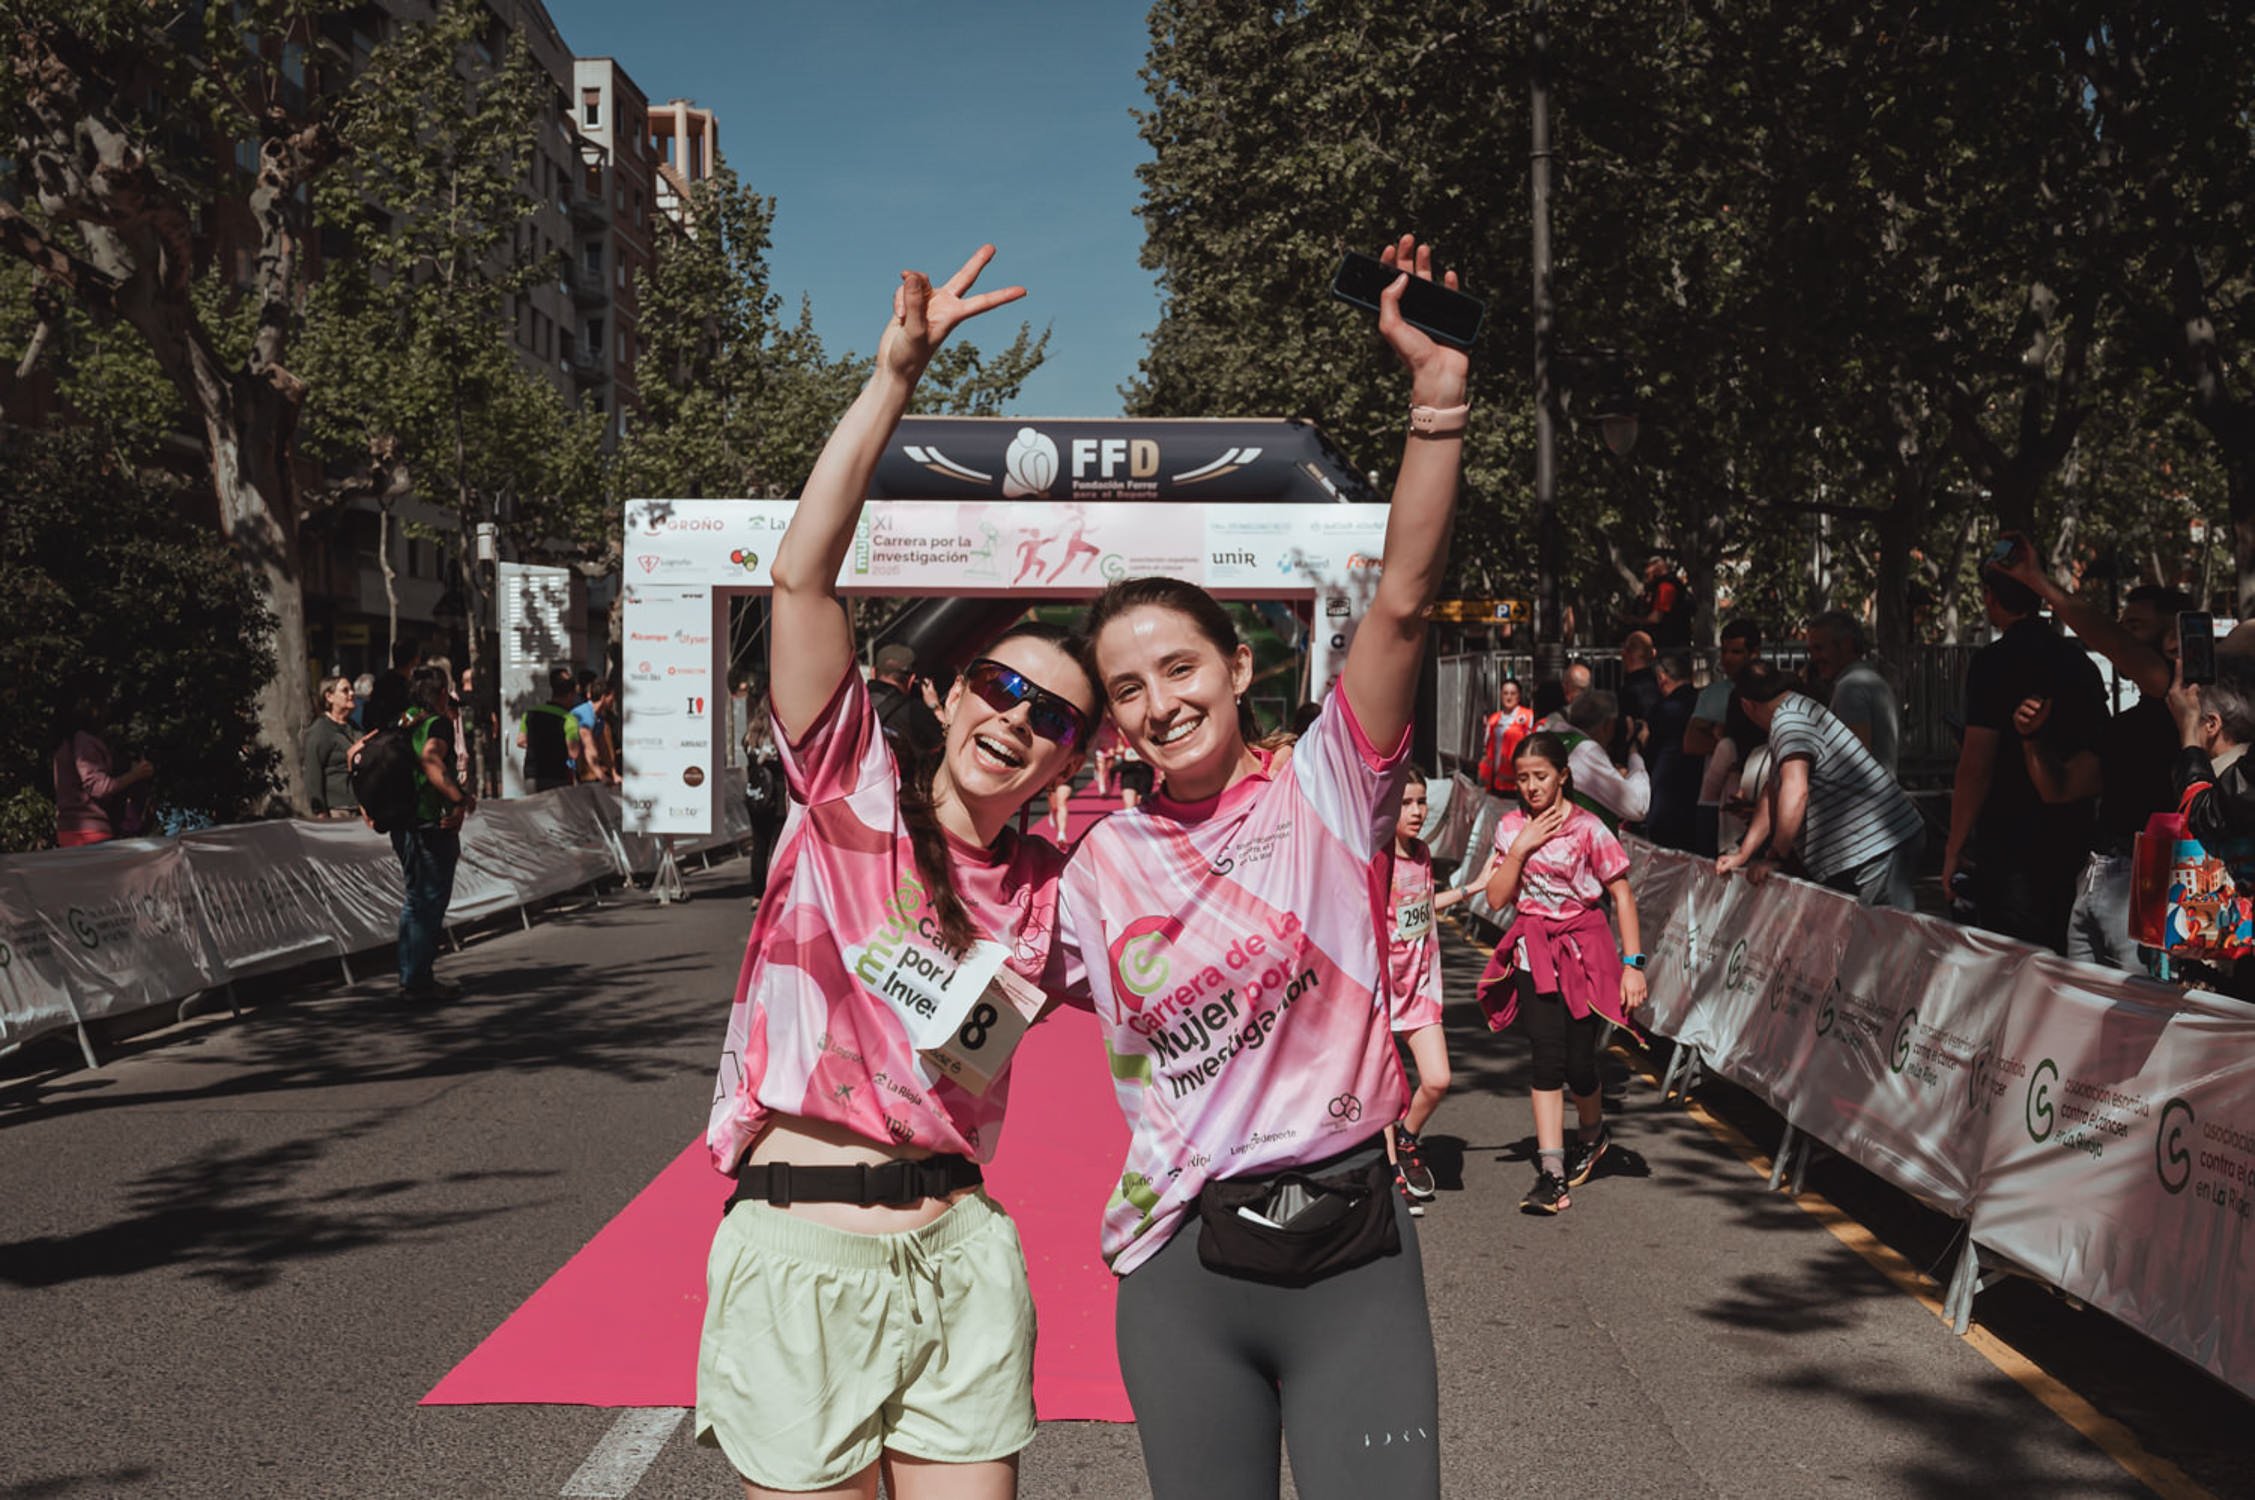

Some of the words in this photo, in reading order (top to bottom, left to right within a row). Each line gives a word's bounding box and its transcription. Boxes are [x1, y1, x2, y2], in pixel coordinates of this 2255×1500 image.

[1072, 439, 1159, 478] FFD
[770, 517, 785, 531] La
[872, 534, 927, 547] Carrera
[930, 538, 954, 549] por
[958, 536, 972, 548] la
[872, 551, 969, 565] investigación
[1496, 604, 1509, 618] P
[855, 869, 923, 985] mujer
[896, 946, 944, 982] por
[940, 969, 957, 992] l
[1128, 965, 1226, 1037] Carrera
[1224, 934, 1267, 971] de
[960, 1003, 999, 1051] 8
[1147, 987, 1240, 1069] Mujer
[1241, 957, 1292, 1013] por
[1166, 967, 1320, 1100] Investigaión
[2060, 1102, 2090, 1126] contra
[2200, 1149, 2234, 1179] contra
[2195, 1180, 2212, 1200] en
[2212, 1180, 2227, 1206] La
